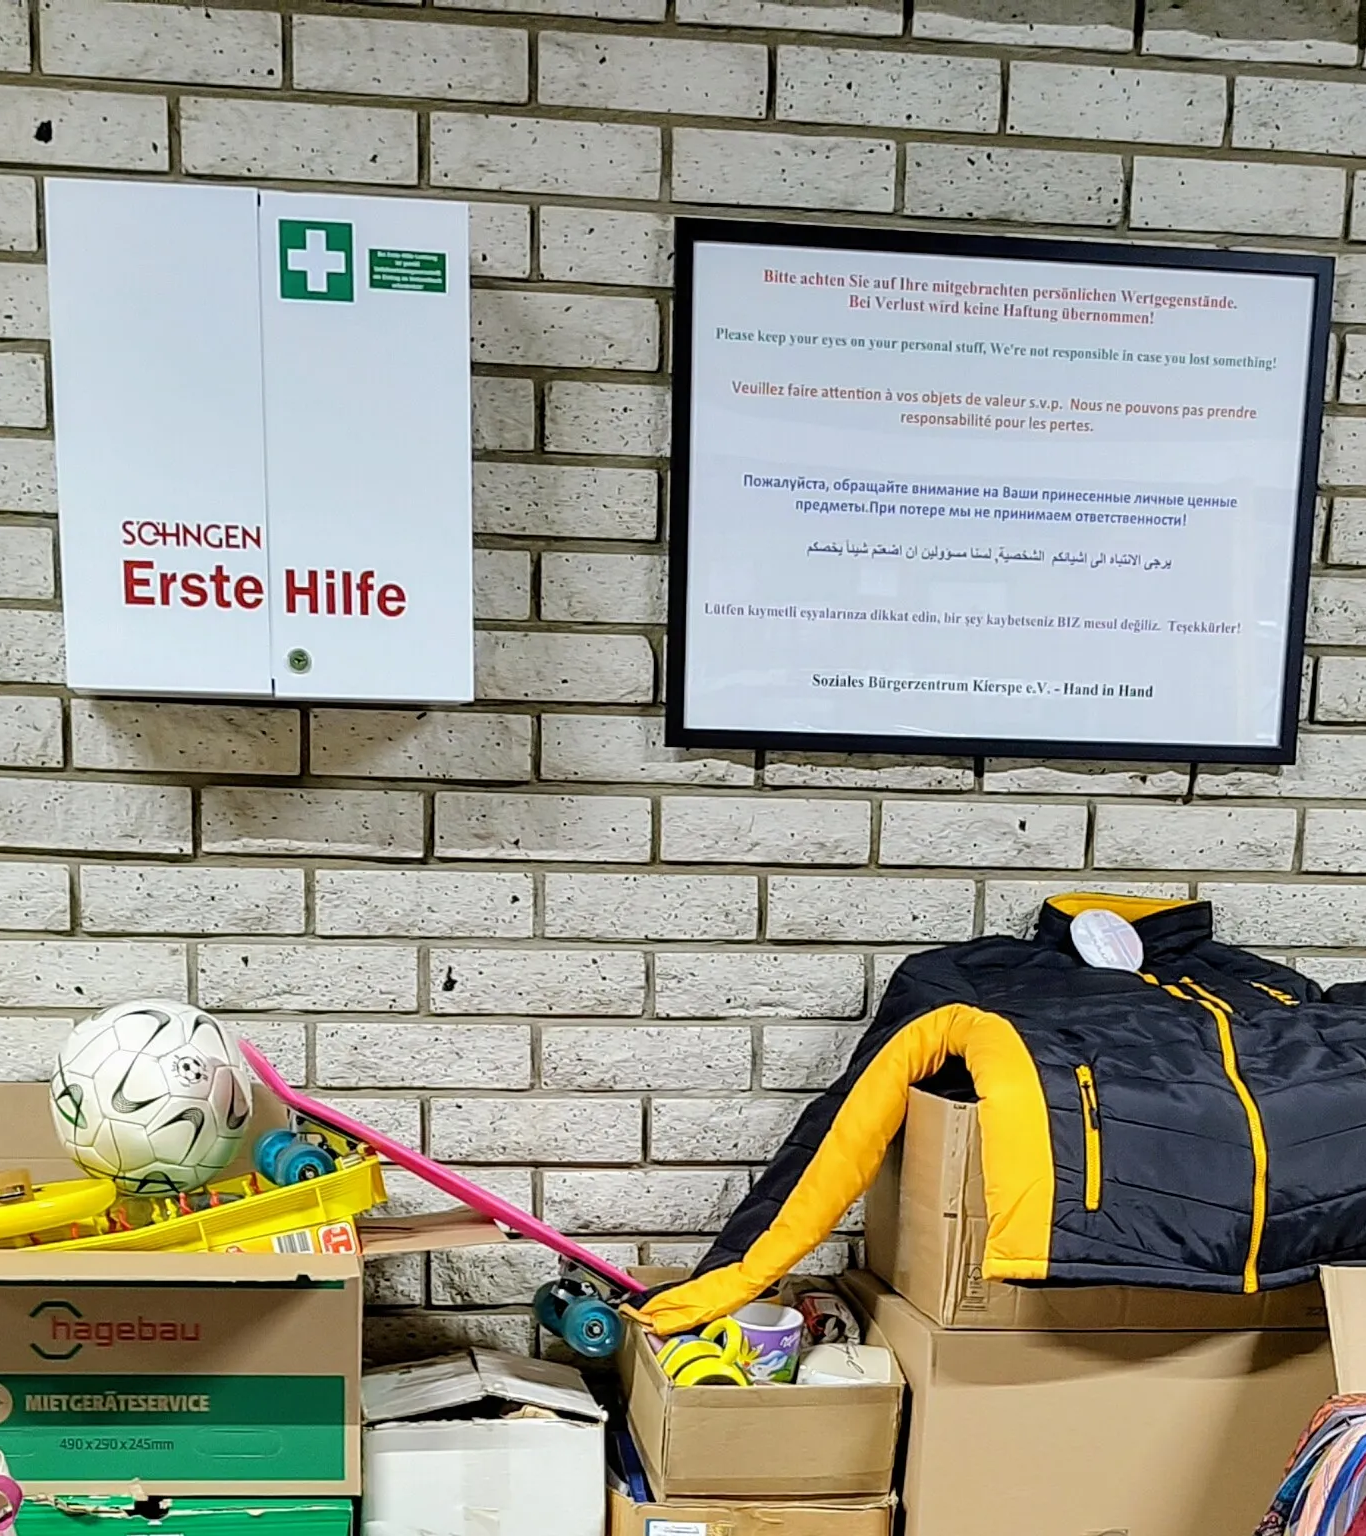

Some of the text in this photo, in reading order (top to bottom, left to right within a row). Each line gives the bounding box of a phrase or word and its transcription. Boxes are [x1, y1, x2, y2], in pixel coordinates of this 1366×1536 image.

[764, 269, 1237, 309] Bitte achten Sie auf Ihre mitgebrachten persönlichen Wertgegenstände.
[849, 295, 1155, 325] Bei Verlust wird keine Haftung übernommen!
[716, 327, 1278, 372] Please keep your eyes on your personal stuff, We're not responsible in case you lost something!
[732, 380, 1257, 420] Veuillez faire attention à vos objets de valeur s.v.p. Nous ne pouvons pas prendre
[901, 411, 1094, 433] responsabilité pour les pertes.
[743, 474, 1238, 510] Пожалуйста, обращайте внимание на Ваши принесенные личные ценные
[899, 504, 946, 519] потере
[949, 506, 971, 518] мы
[974, 507, 990, 519] не
[994, 509, 1071, 524] принимаем
[1075, 511, 1187, 527] ответственности!
[121, 519, 262, 550] SÖHNGEN
[122, 558, 408, 617] Erste Hilfe
[704, 603, 744, 616] Lütfen
[747, 604, 797, 621] kıymetli
[870, 609, 908, 623] dikkat
[912, 610, 941, 624] edin,
[944, 611, 961, 624] bir
[964, 615, 983, 627] şey
[986, 613, 1055, 629] kaybetseniz
[1084, 617, 1117, 630] mesul
[1168, 620, 1241, 635] Teşekkürler!
[812, 674, 1153, 698] Soziales Bürgerzentrum Kierspe e.V. Hand in Hand
[50, 1314, 201, 1347] hagebau
[25, 1390, 211, 1413] MIETGERÄTESERVICE
